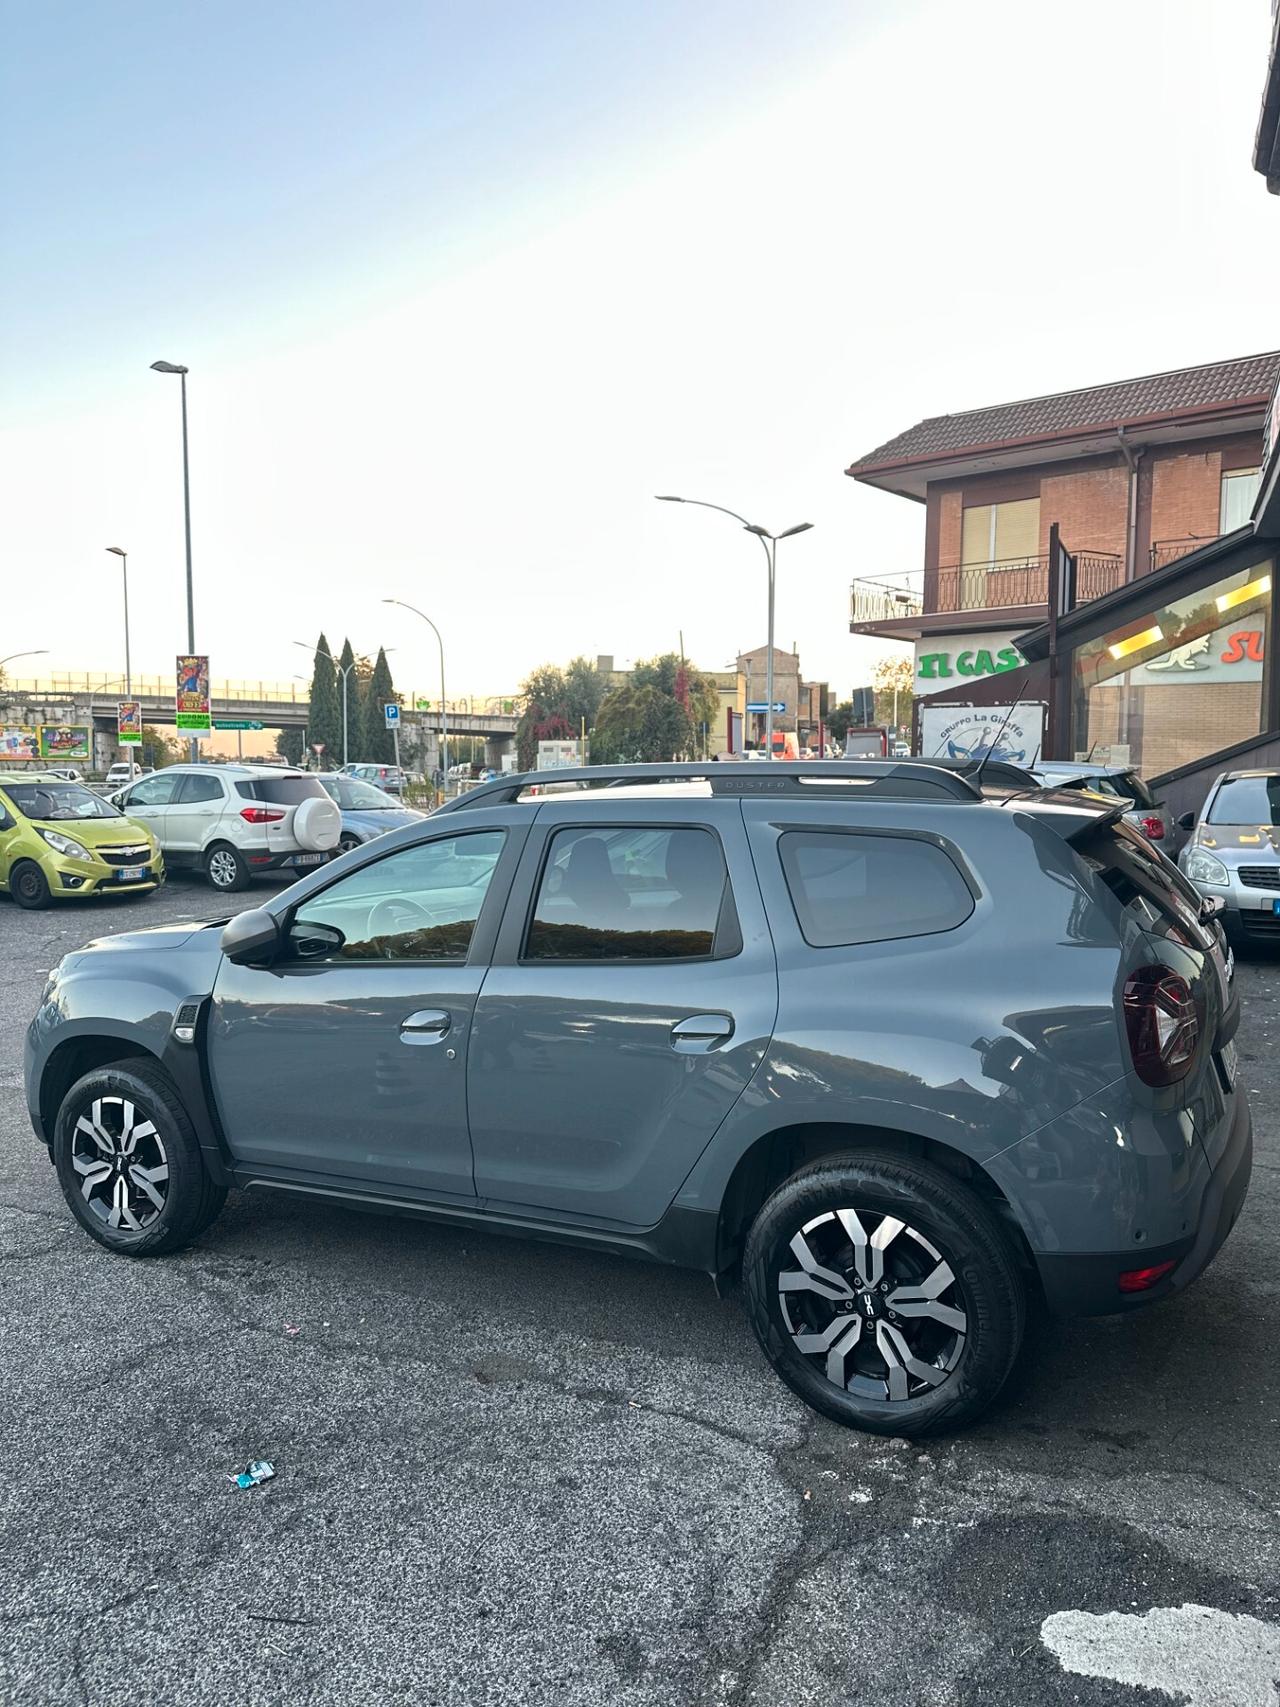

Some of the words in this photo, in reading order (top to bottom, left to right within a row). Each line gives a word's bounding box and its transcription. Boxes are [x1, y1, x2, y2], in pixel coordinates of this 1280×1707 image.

[389, 707, 395, 717] P
[940, 716, 972, 739] GRUPPO
[974, 714, 987, 722] La
[991, 714, 1024, 738] Giraffa
